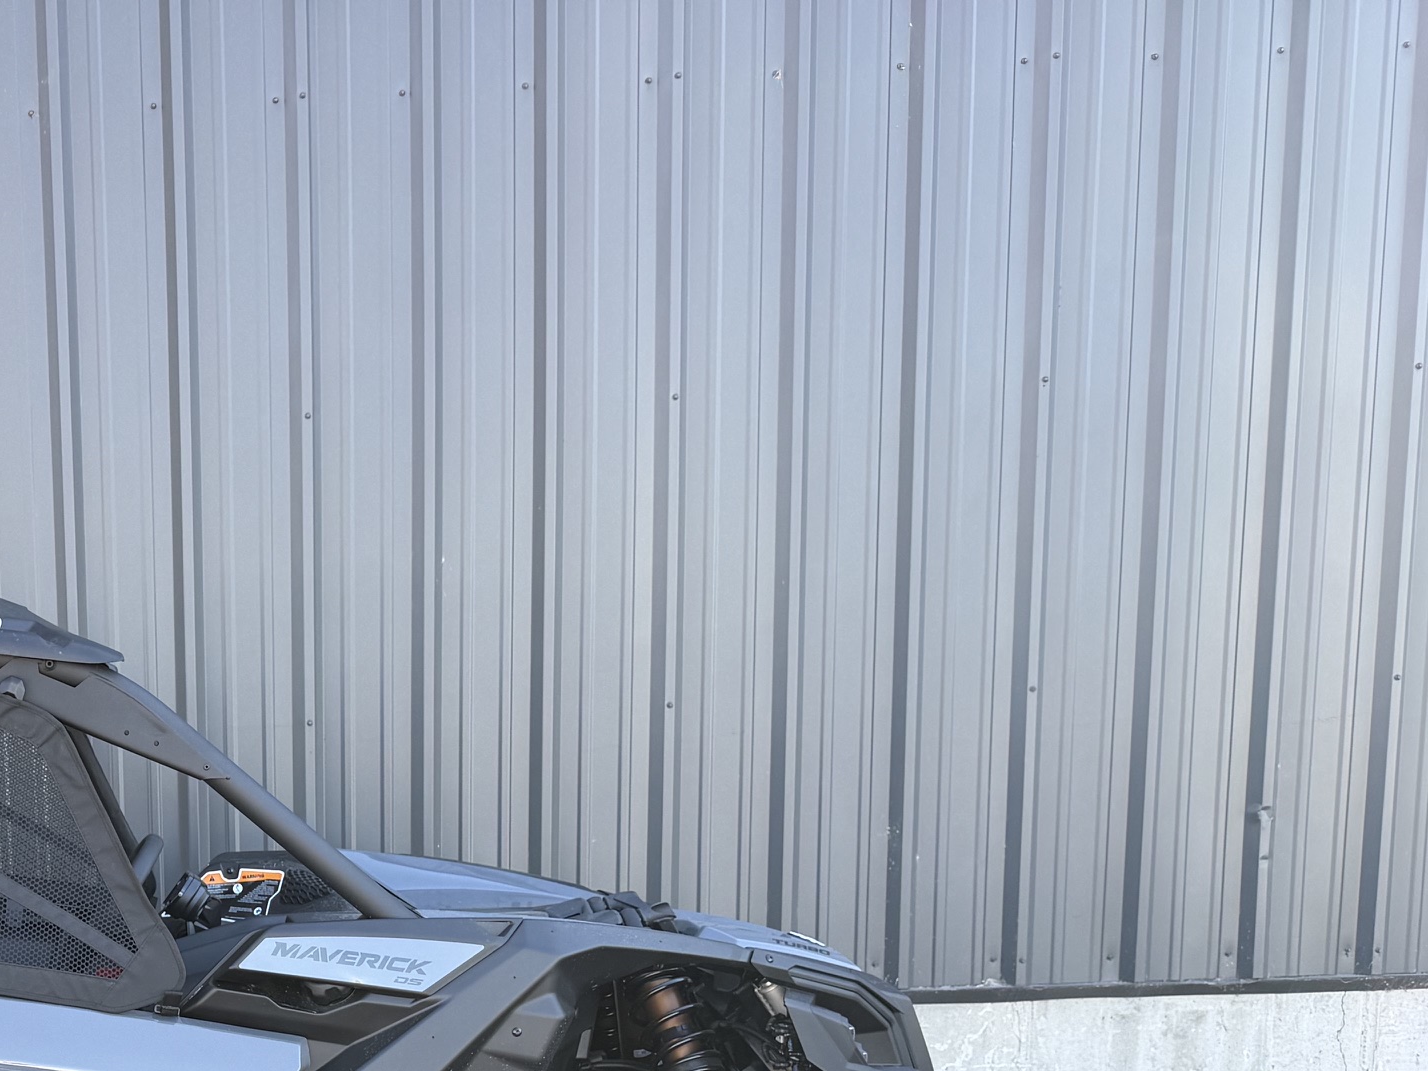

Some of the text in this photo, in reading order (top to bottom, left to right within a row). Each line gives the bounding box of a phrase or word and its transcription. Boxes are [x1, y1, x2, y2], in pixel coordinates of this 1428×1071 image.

[772, 938, 831, 956] TURBO
[271, 941, 432, 975] MAVERICK
[393, 976, 424, 986] DS
